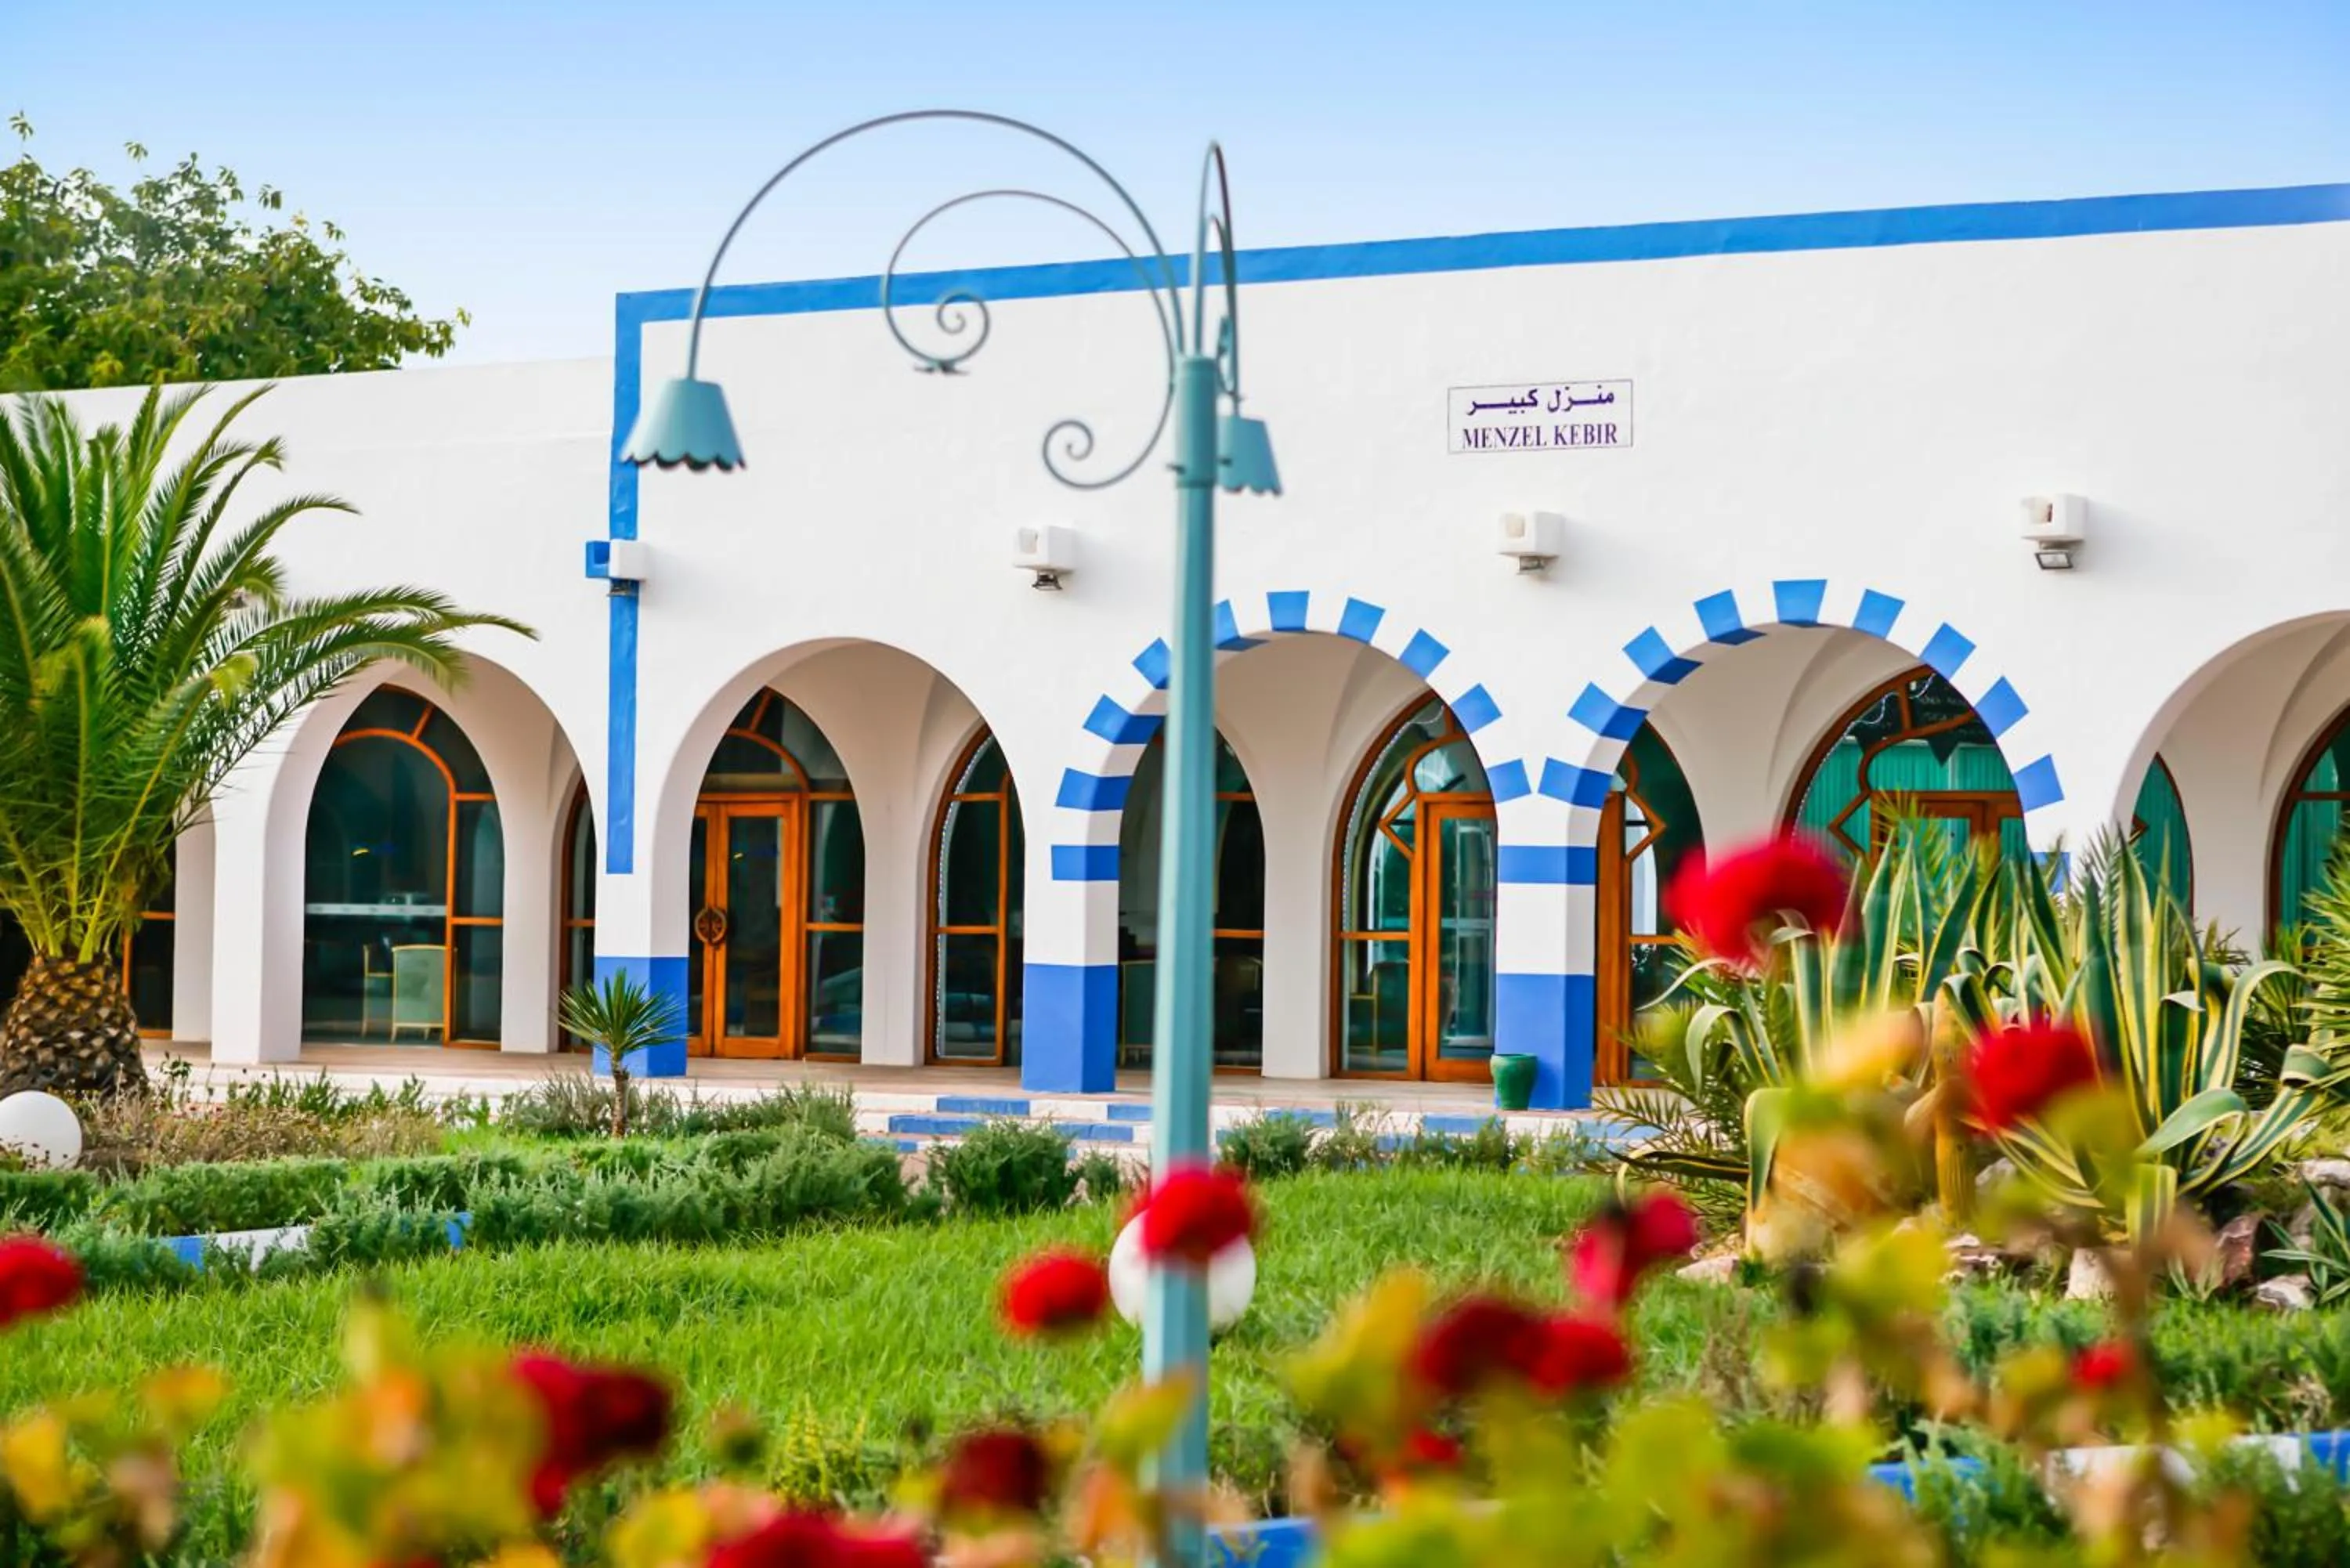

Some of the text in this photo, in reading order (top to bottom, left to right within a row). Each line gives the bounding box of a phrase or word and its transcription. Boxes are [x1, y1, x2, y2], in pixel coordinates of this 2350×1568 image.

[1466, 384, 1614, 416] منزل كبير
[1462, 423, 1618, 449] MENZEL KEBIR
